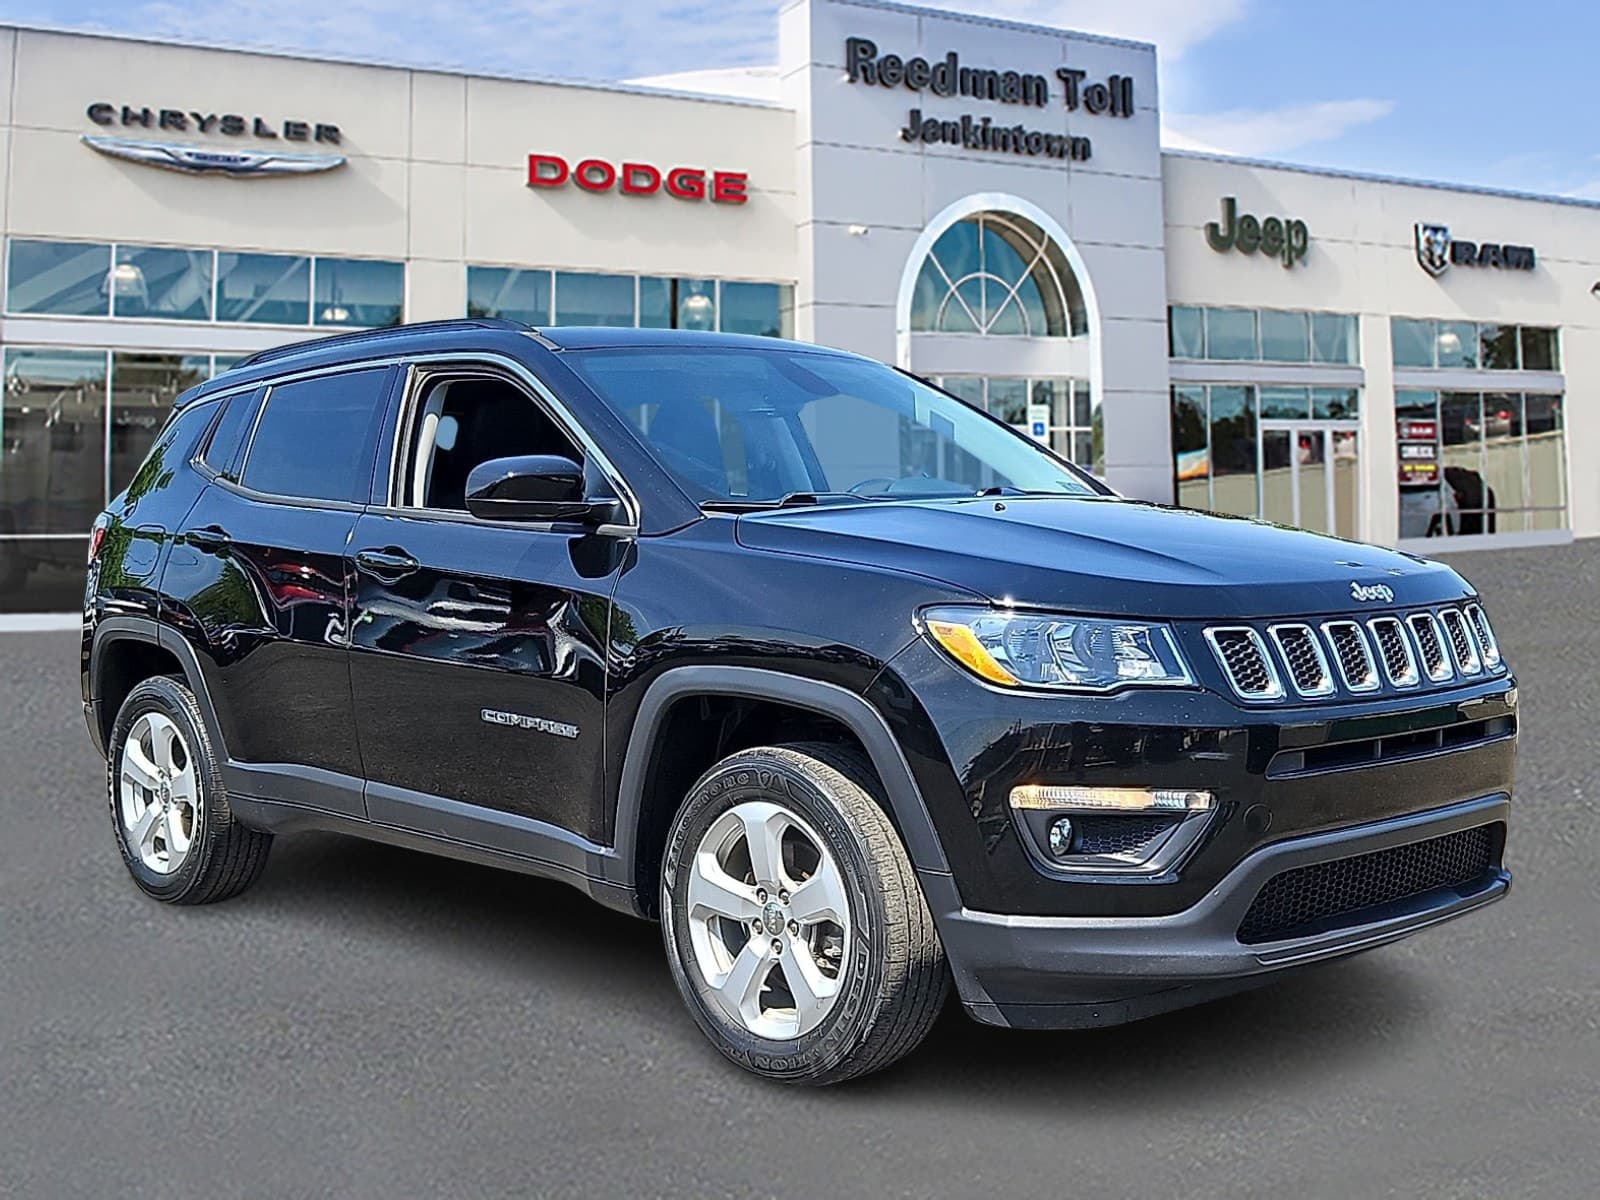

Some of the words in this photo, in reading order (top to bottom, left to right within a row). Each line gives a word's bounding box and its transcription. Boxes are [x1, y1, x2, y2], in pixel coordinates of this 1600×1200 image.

[846, 37, 1049, 108] Reedman
[1056, 67, 1135, 118] Toll
[87, 102, 342, 145] CHRYSLER
[900, 109, 1092, 161] Jenkintown
[526, 153, 749, 205] DODGE
[1205, 197, 1309, 269] Jeep
[1450, 240, 1536, 271] RAM
[1349, 580, 1395, 604] Jeep
[480, 708, 580, 739] COMPASS
